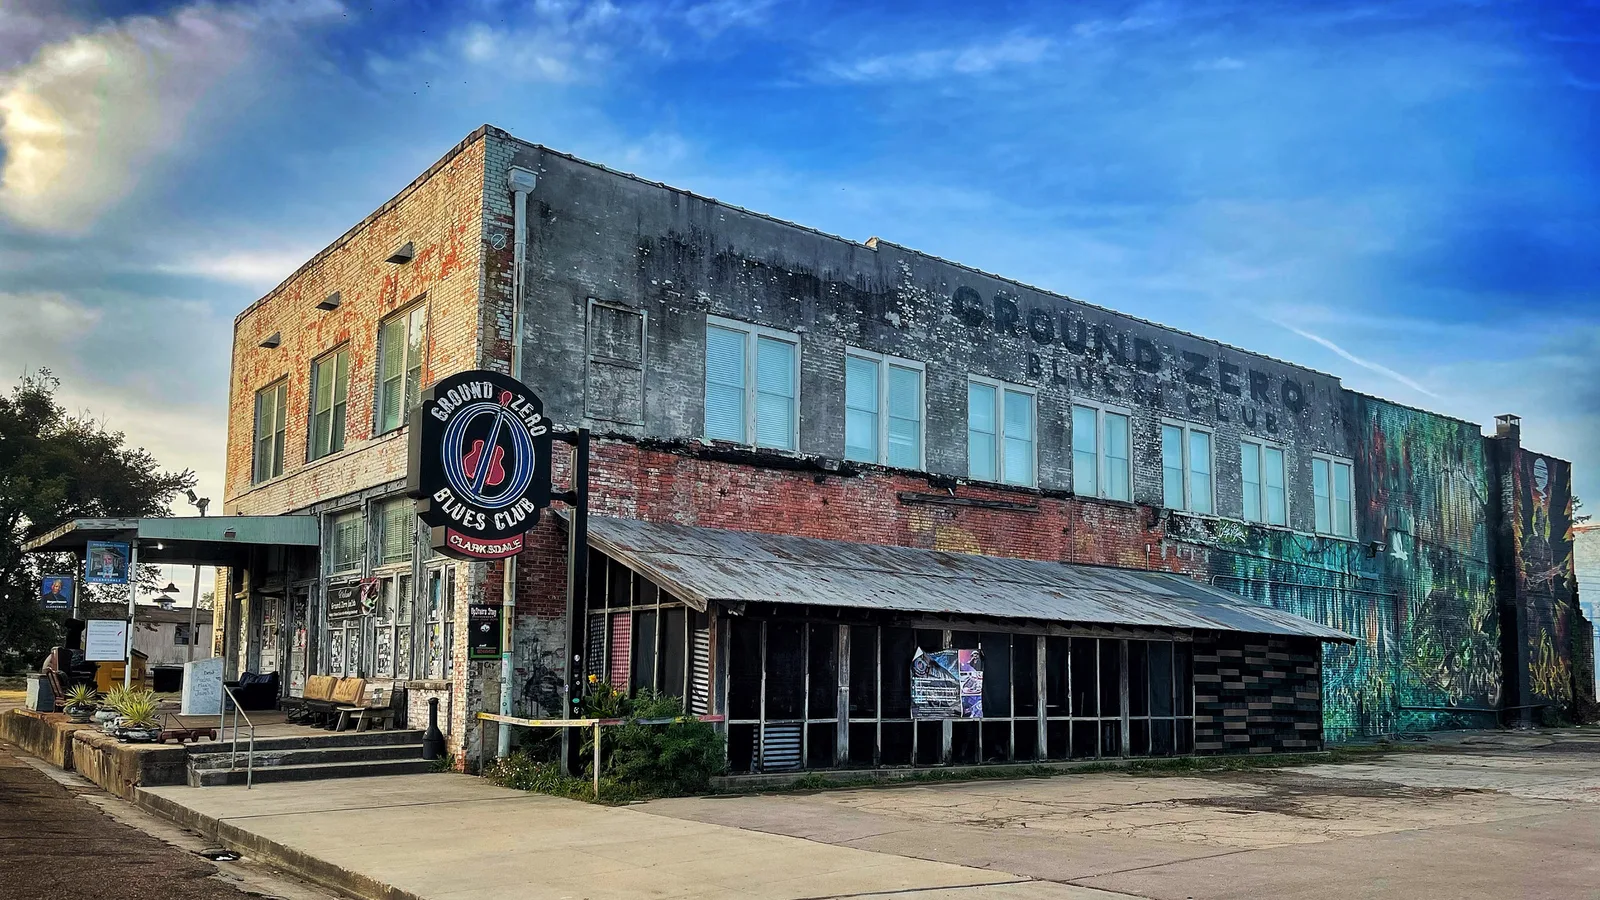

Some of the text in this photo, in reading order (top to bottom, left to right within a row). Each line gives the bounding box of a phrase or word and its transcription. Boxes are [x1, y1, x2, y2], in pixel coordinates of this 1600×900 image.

[952, 286, 1305, 413] GROUND ZERO
[431, 381, 547, 437] GROUND ZERO
[1186, 392, 1278, 433] CLUB
[433, 487, 535, 531] BLUES CLUB
[449, 535, 522, 554] CLARKSDALE
